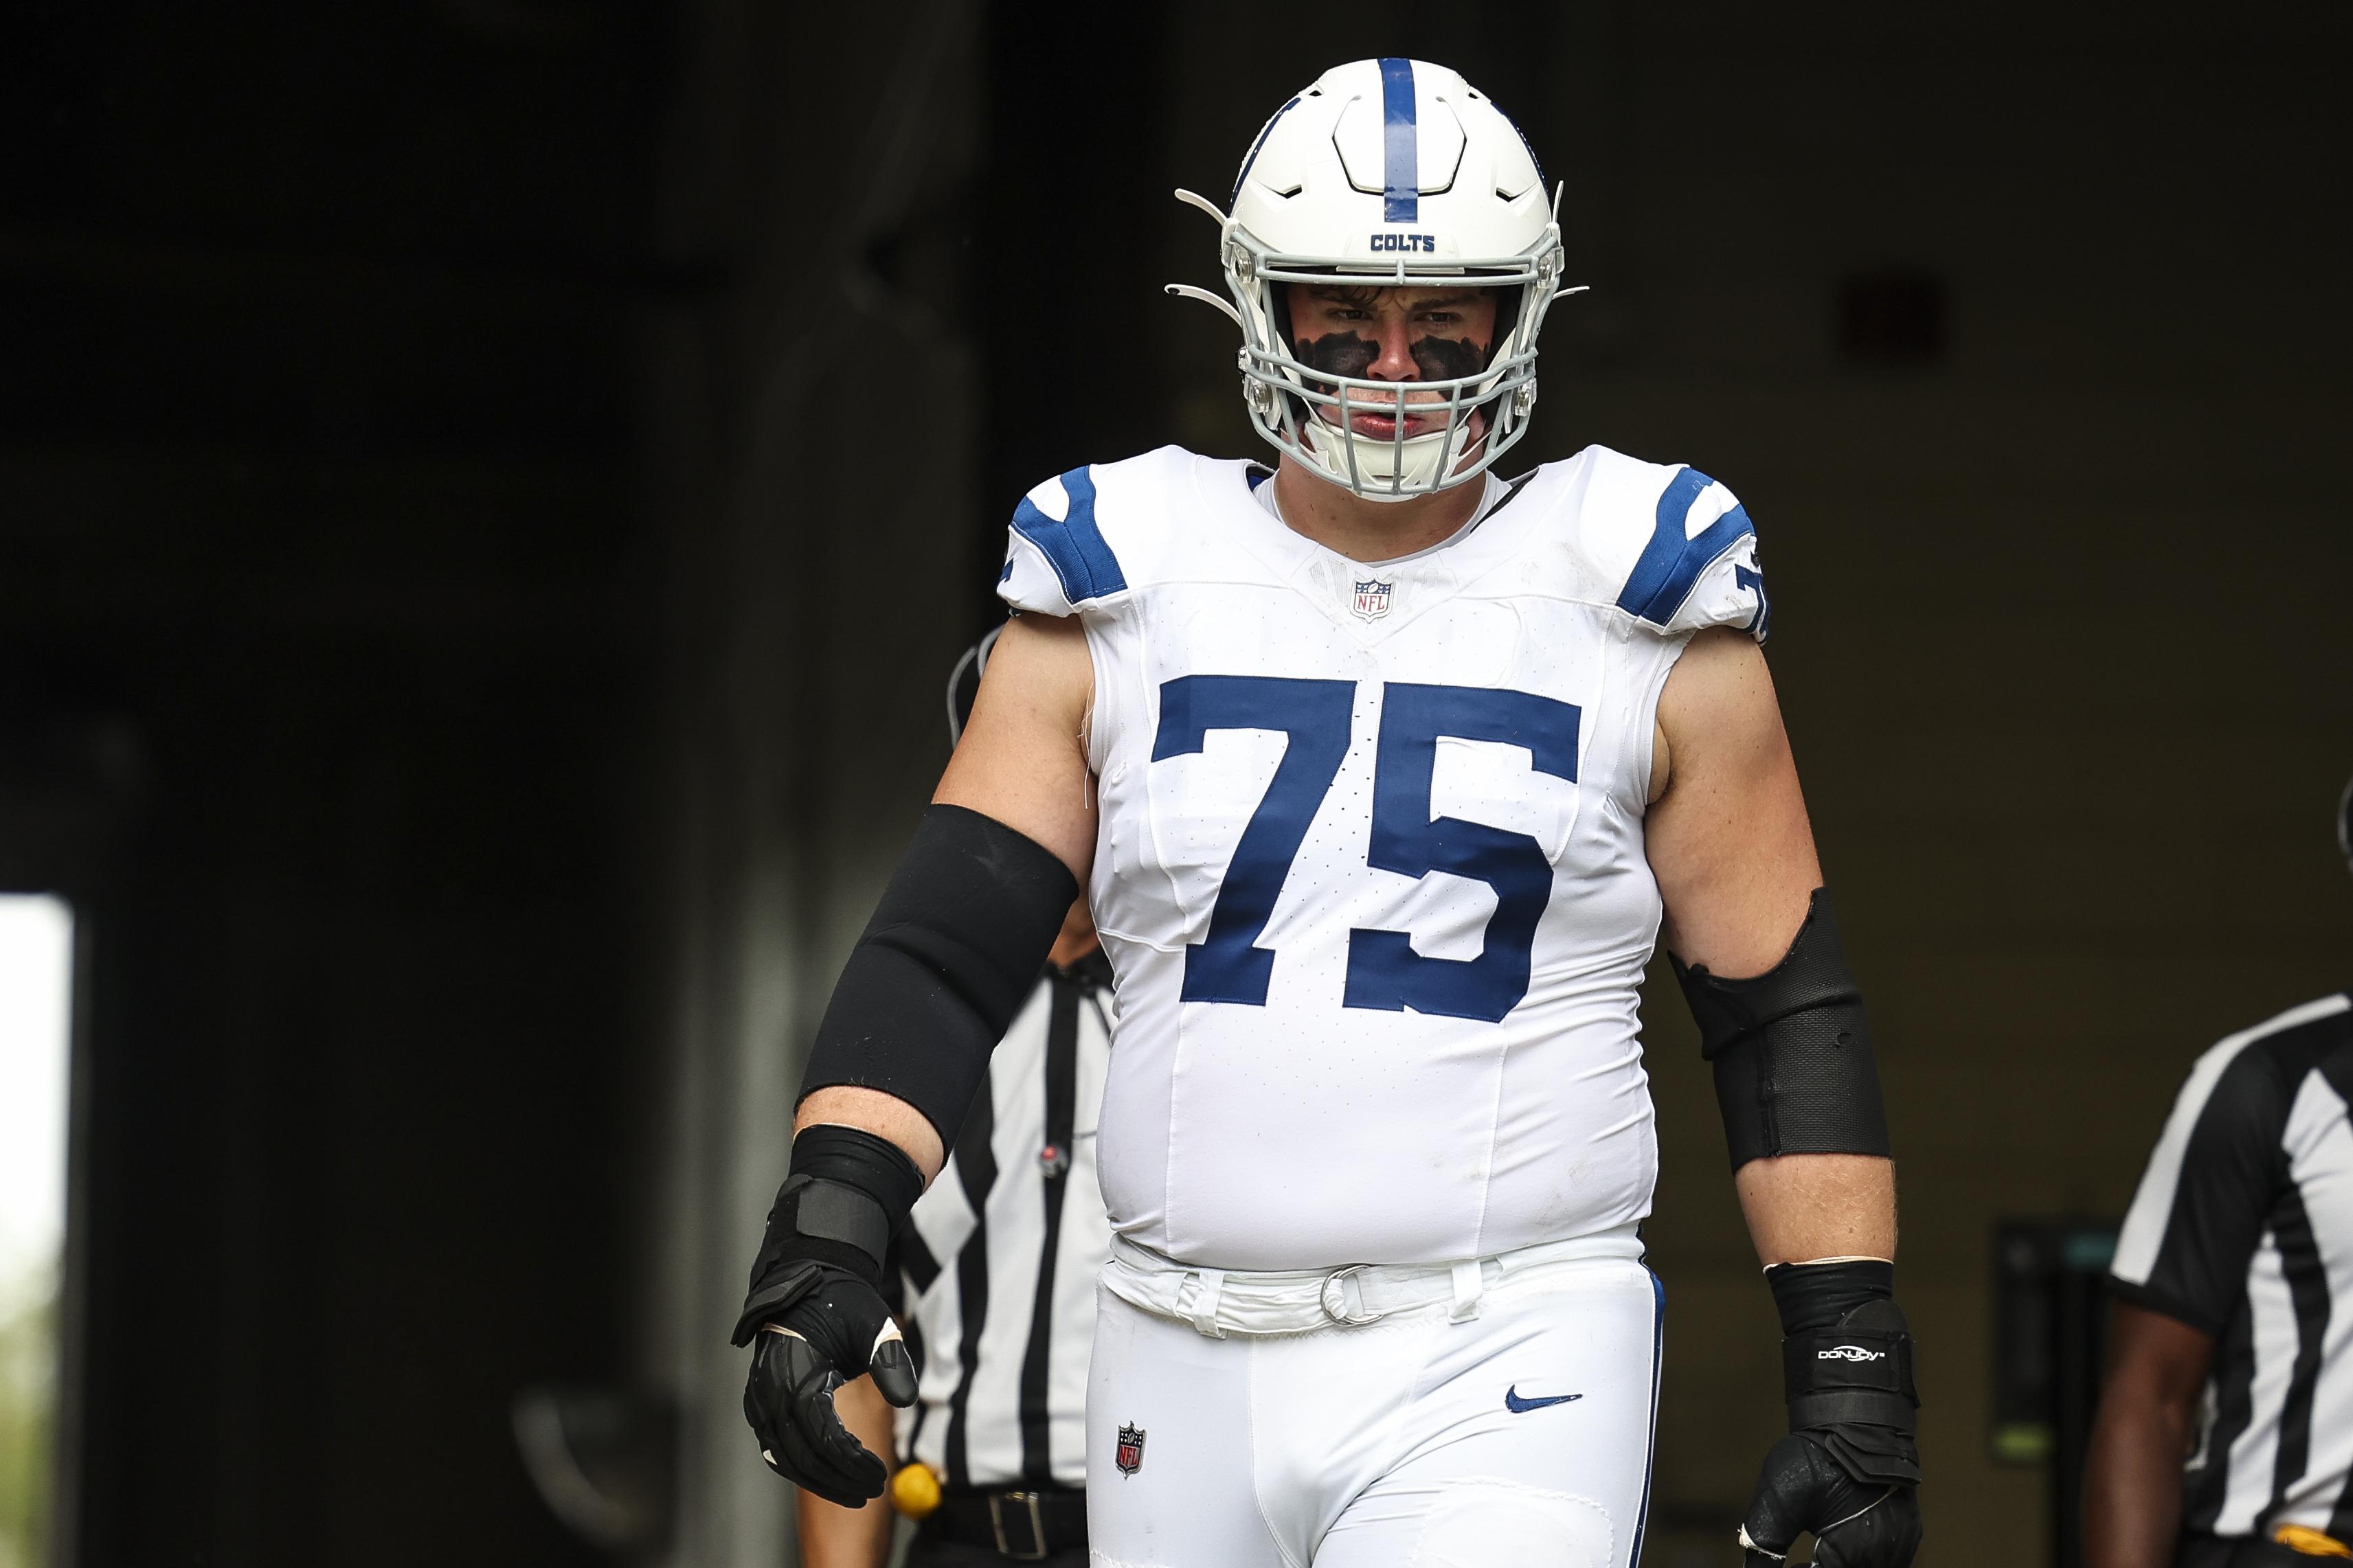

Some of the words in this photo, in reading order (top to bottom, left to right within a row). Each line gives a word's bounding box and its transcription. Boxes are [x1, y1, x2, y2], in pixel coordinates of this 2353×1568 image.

[1371, 234, 1434, 252] COLTS
[1357, 595, 1385, 612] NFL
[1151, 674, 1581, 1023] 75
[1118, 1445, 1138, 1467] NFL
